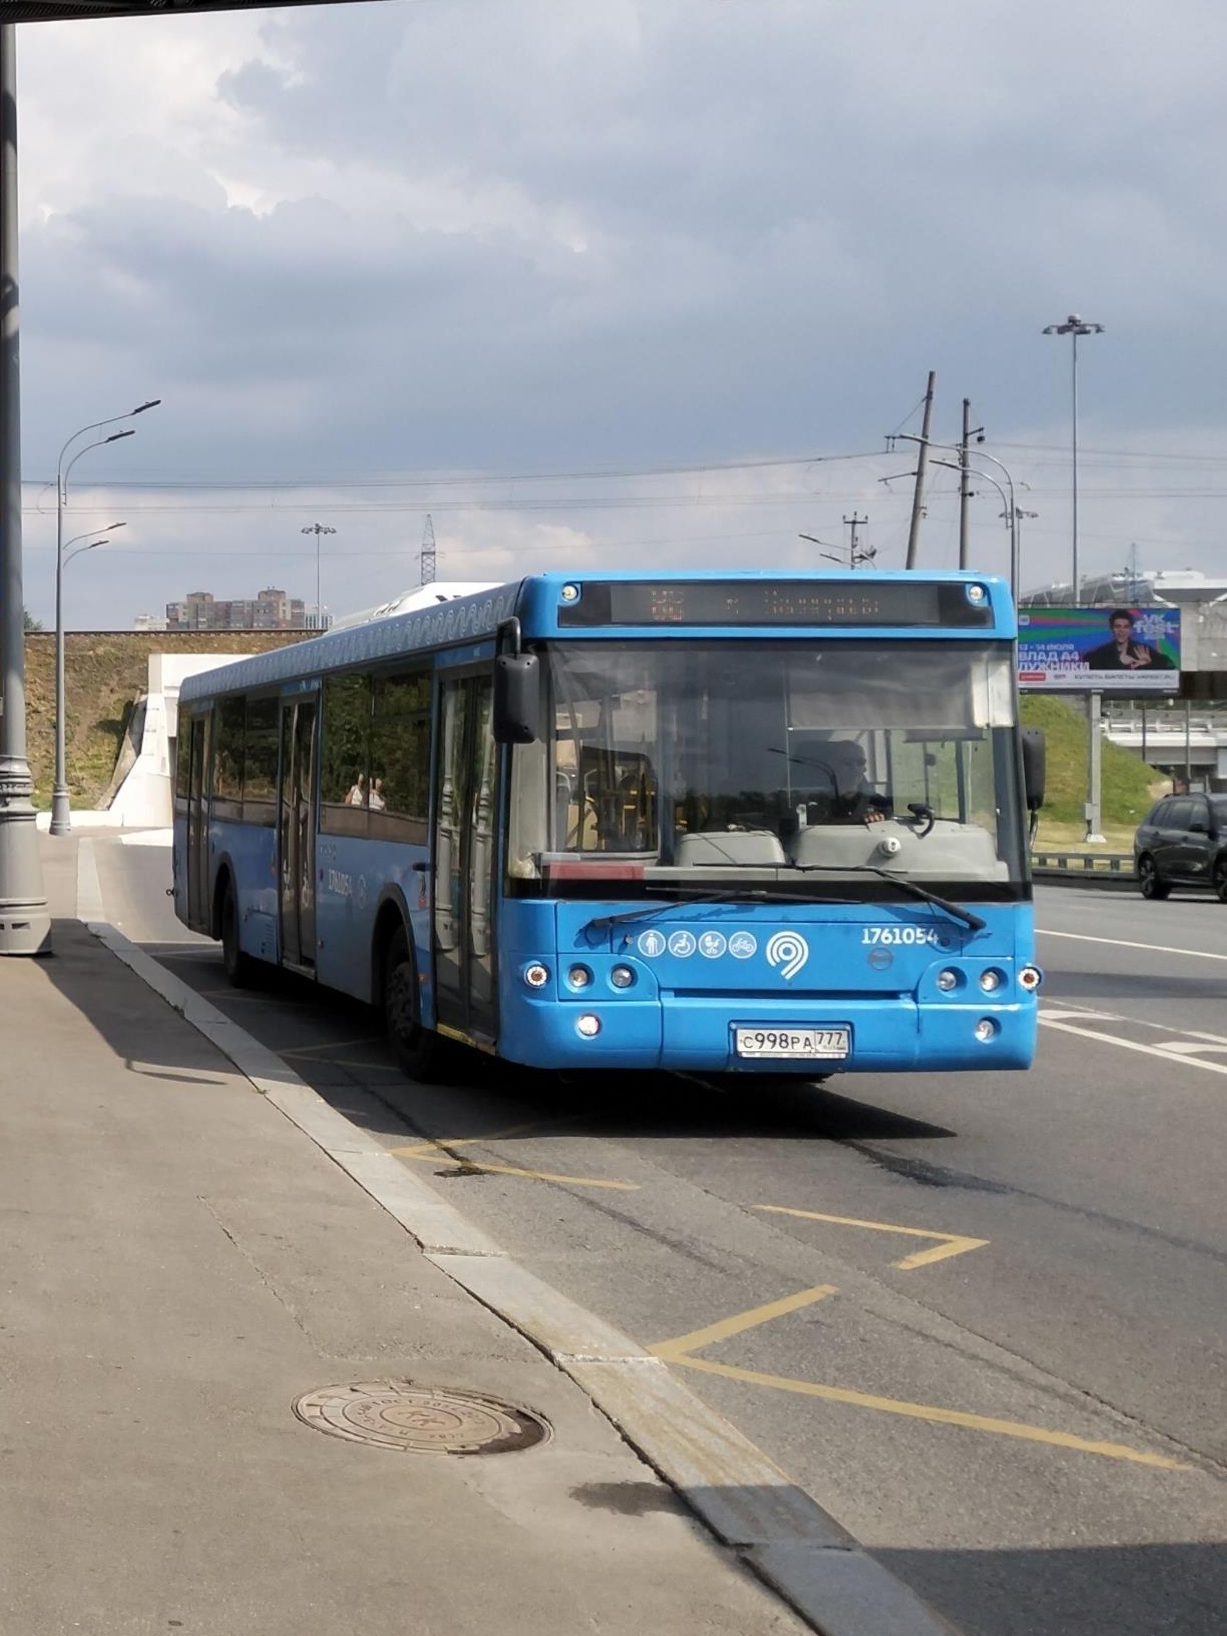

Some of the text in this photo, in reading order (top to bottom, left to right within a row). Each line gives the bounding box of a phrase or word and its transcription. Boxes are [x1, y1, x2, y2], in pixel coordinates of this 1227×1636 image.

[1019, 651, 1059, 662] ВЛАД
[1019, 661, 1090, 671] ЛУЖНИКИ
[861, 928, 939, 945] 1761054
[743, 1032, 843, 1050] С998РА 777
